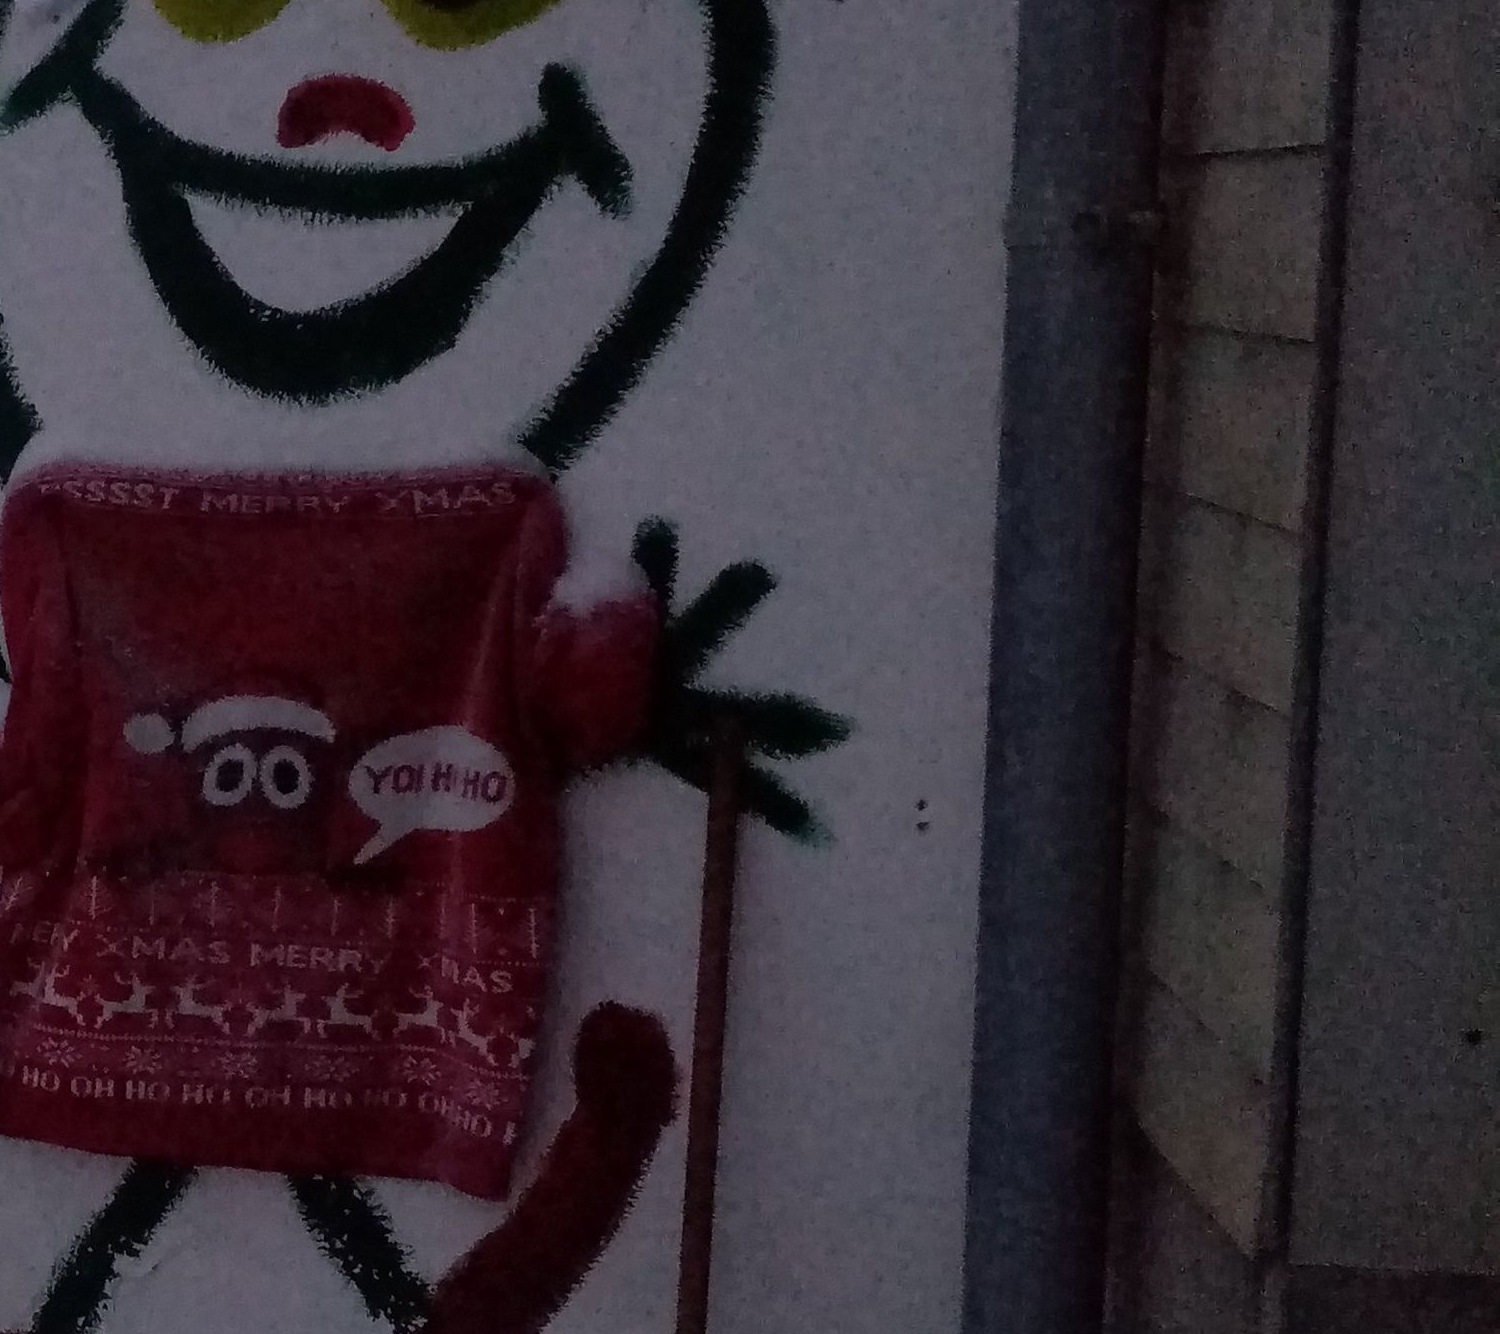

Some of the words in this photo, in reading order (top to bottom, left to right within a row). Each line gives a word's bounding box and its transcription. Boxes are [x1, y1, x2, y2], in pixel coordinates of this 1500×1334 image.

[375, 482, 517, 515] XMAS
[95, 933, 230, 964] XMAS
[250, 942, 390, 974] MERRY
[22, 1065, 61, 1091] HO
[70, 1076, 114, 1098] OH
[125, 1079, 170, 1100] HO
